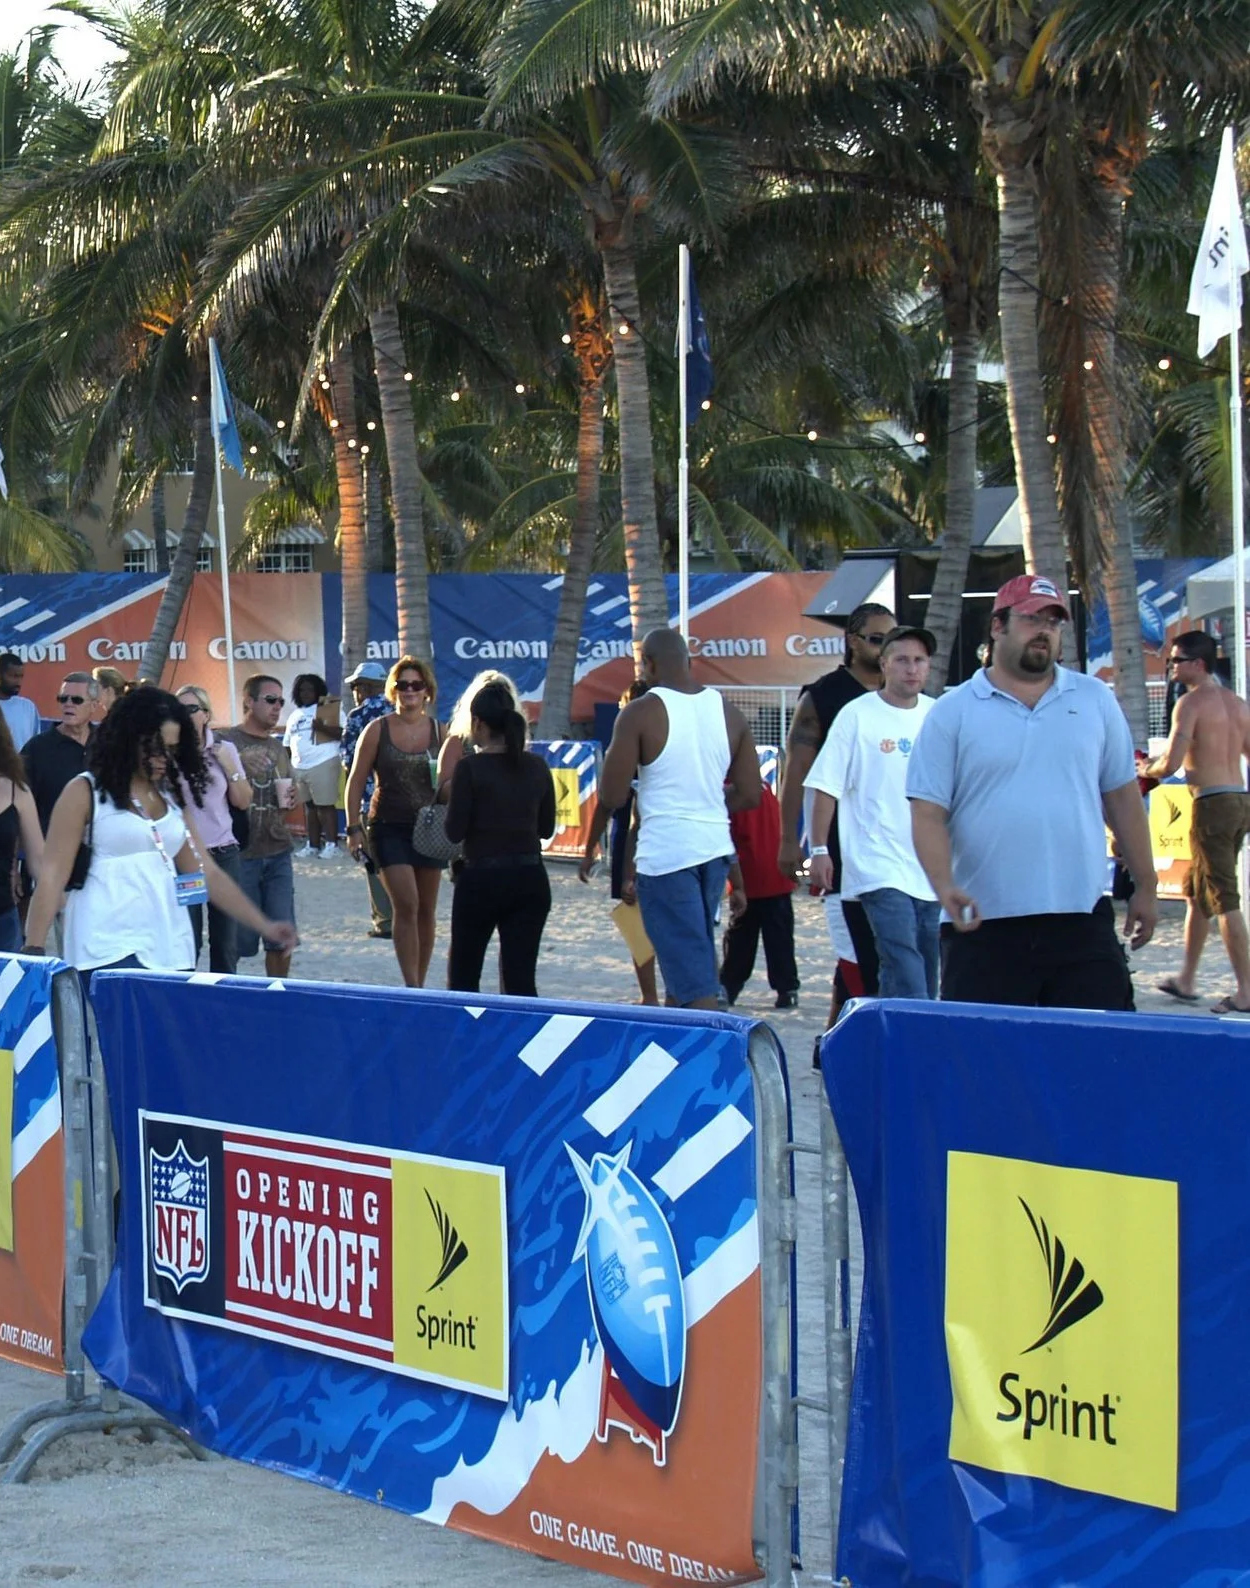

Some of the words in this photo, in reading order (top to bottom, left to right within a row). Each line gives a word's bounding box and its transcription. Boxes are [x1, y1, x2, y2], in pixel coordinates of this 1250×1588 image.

[87, 638, 187, 661] Cann
[209, 637, 307, 661] Canon
[454, 636, 548, 659] Canon
[785, 634, 846, 657] Can
[236, 1168, 379, 1225] OPENING
[154, 1204, 205, 1275] NFL
[237, 1209, 380, 1319] KICKOFF
[0, 1323, 20, 1346] ONE
[20, 1330, 55, 1358] DREAM.
[416, 1304, 478, 1350] Sprint
[996, 1372, 1120, 1446] Sprint
[530, 1510, 564, 1542] ONE
[567, 1522, 625, 1560] GAME.
[626, 1540, 666, 1573] ONE
